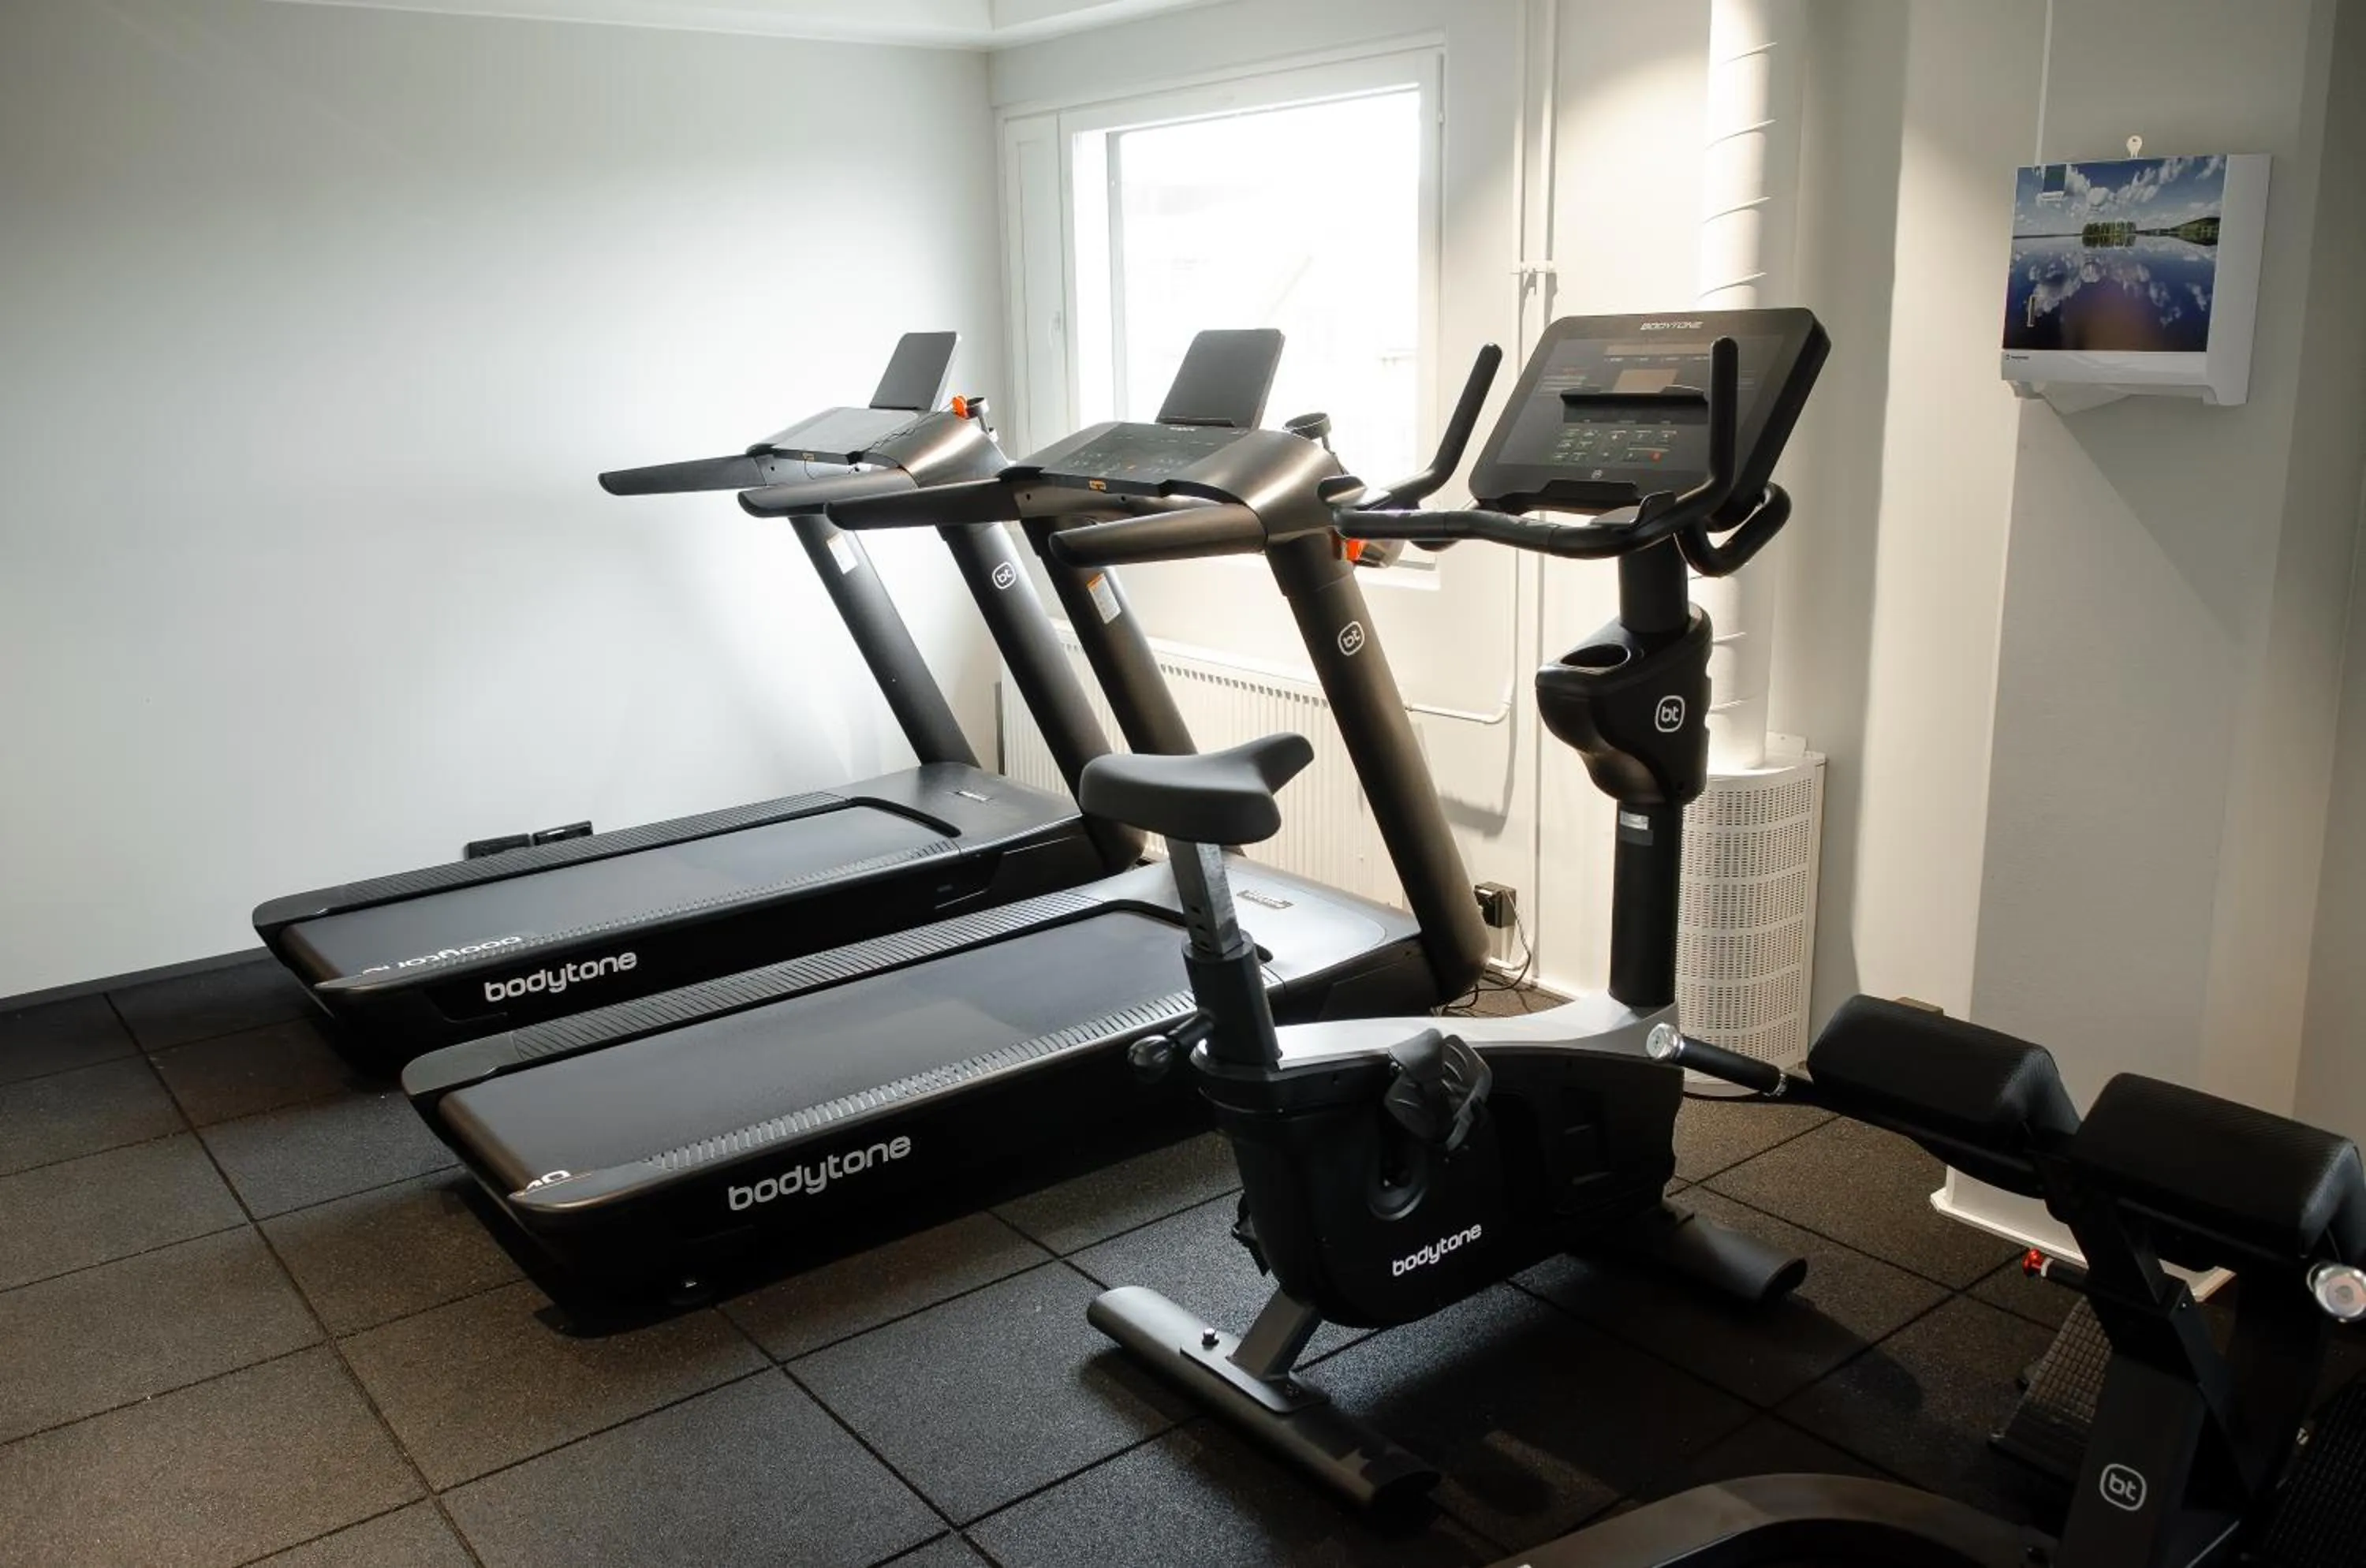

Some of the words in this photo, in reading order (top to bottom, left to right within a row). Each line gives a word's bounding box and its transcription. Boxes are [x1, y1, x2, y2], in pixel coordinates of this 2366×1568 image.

[483, 951, 638, 1002] bodytone
[727, 1135, 912, 1211] bodytone
[1391, 1223, 1483, 1277] bodytone
